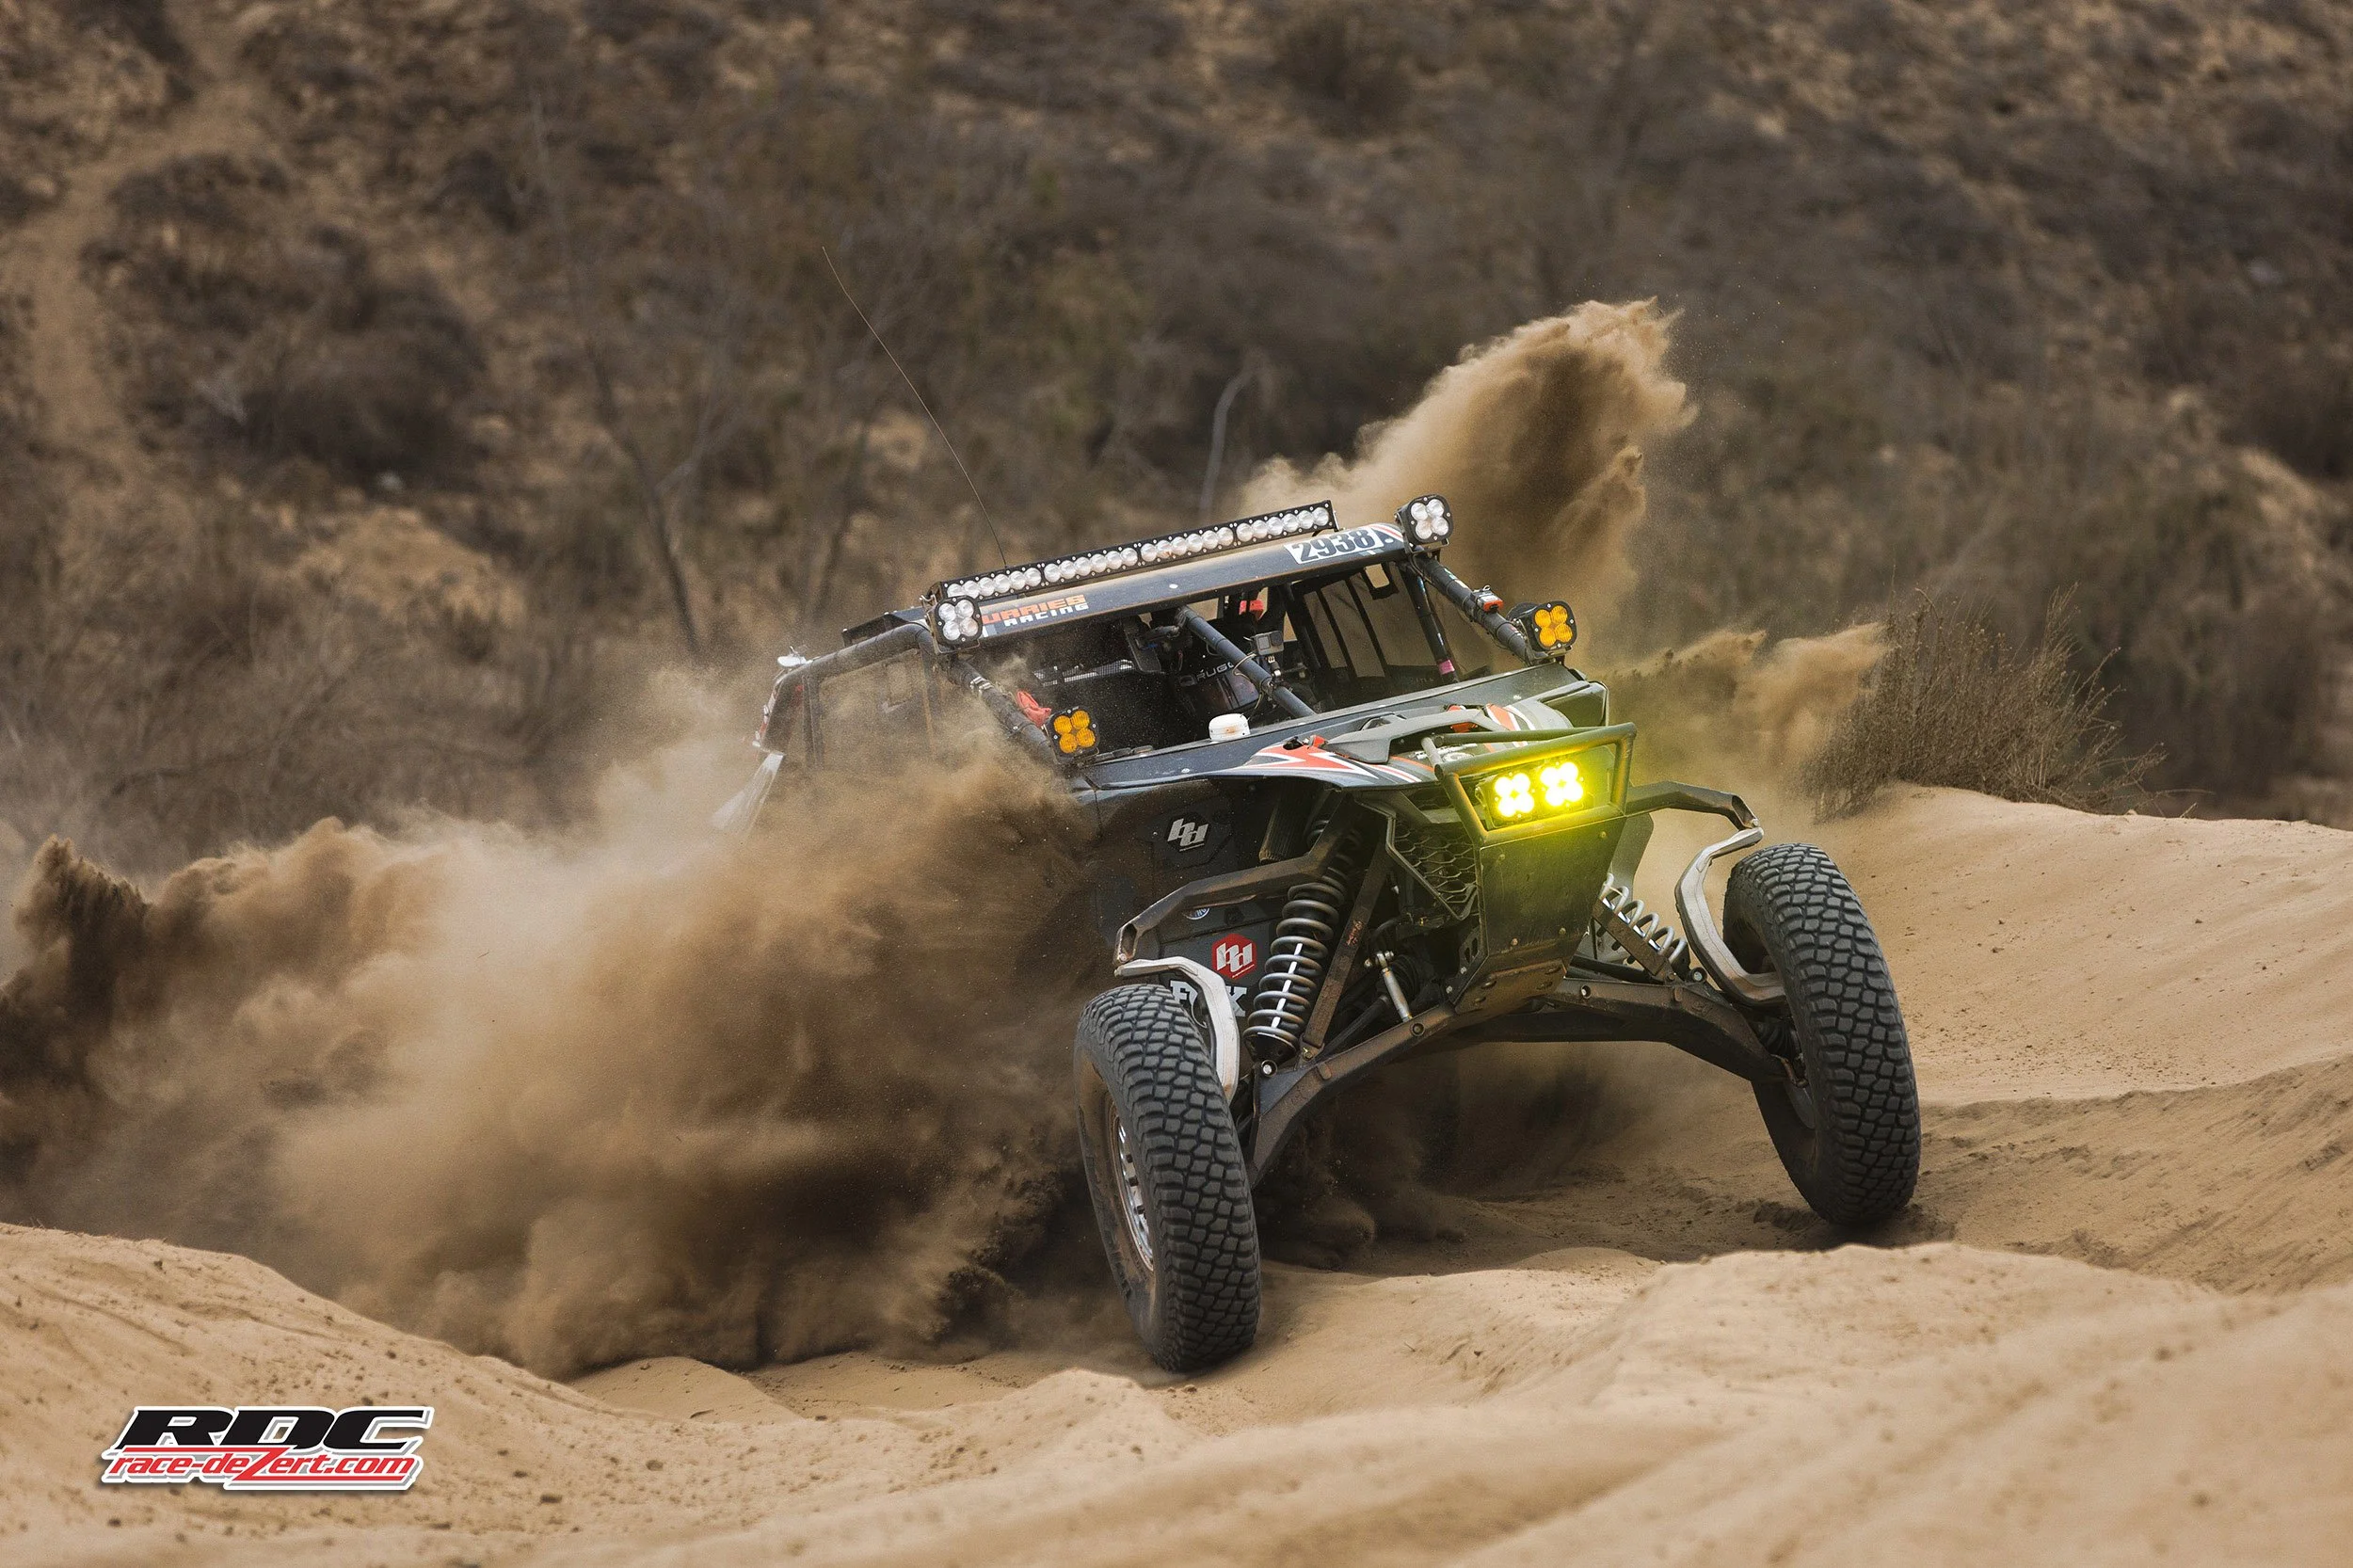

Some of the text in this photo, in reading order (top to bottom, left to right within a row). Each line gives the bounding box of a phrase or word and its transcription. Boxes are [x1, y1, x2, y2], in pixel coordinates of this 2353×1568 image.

[1292, 529, 1376, 562] 2938
[981, 595, 1087, 625] URRIES
[1003, 603, 1090, 627] RACING
